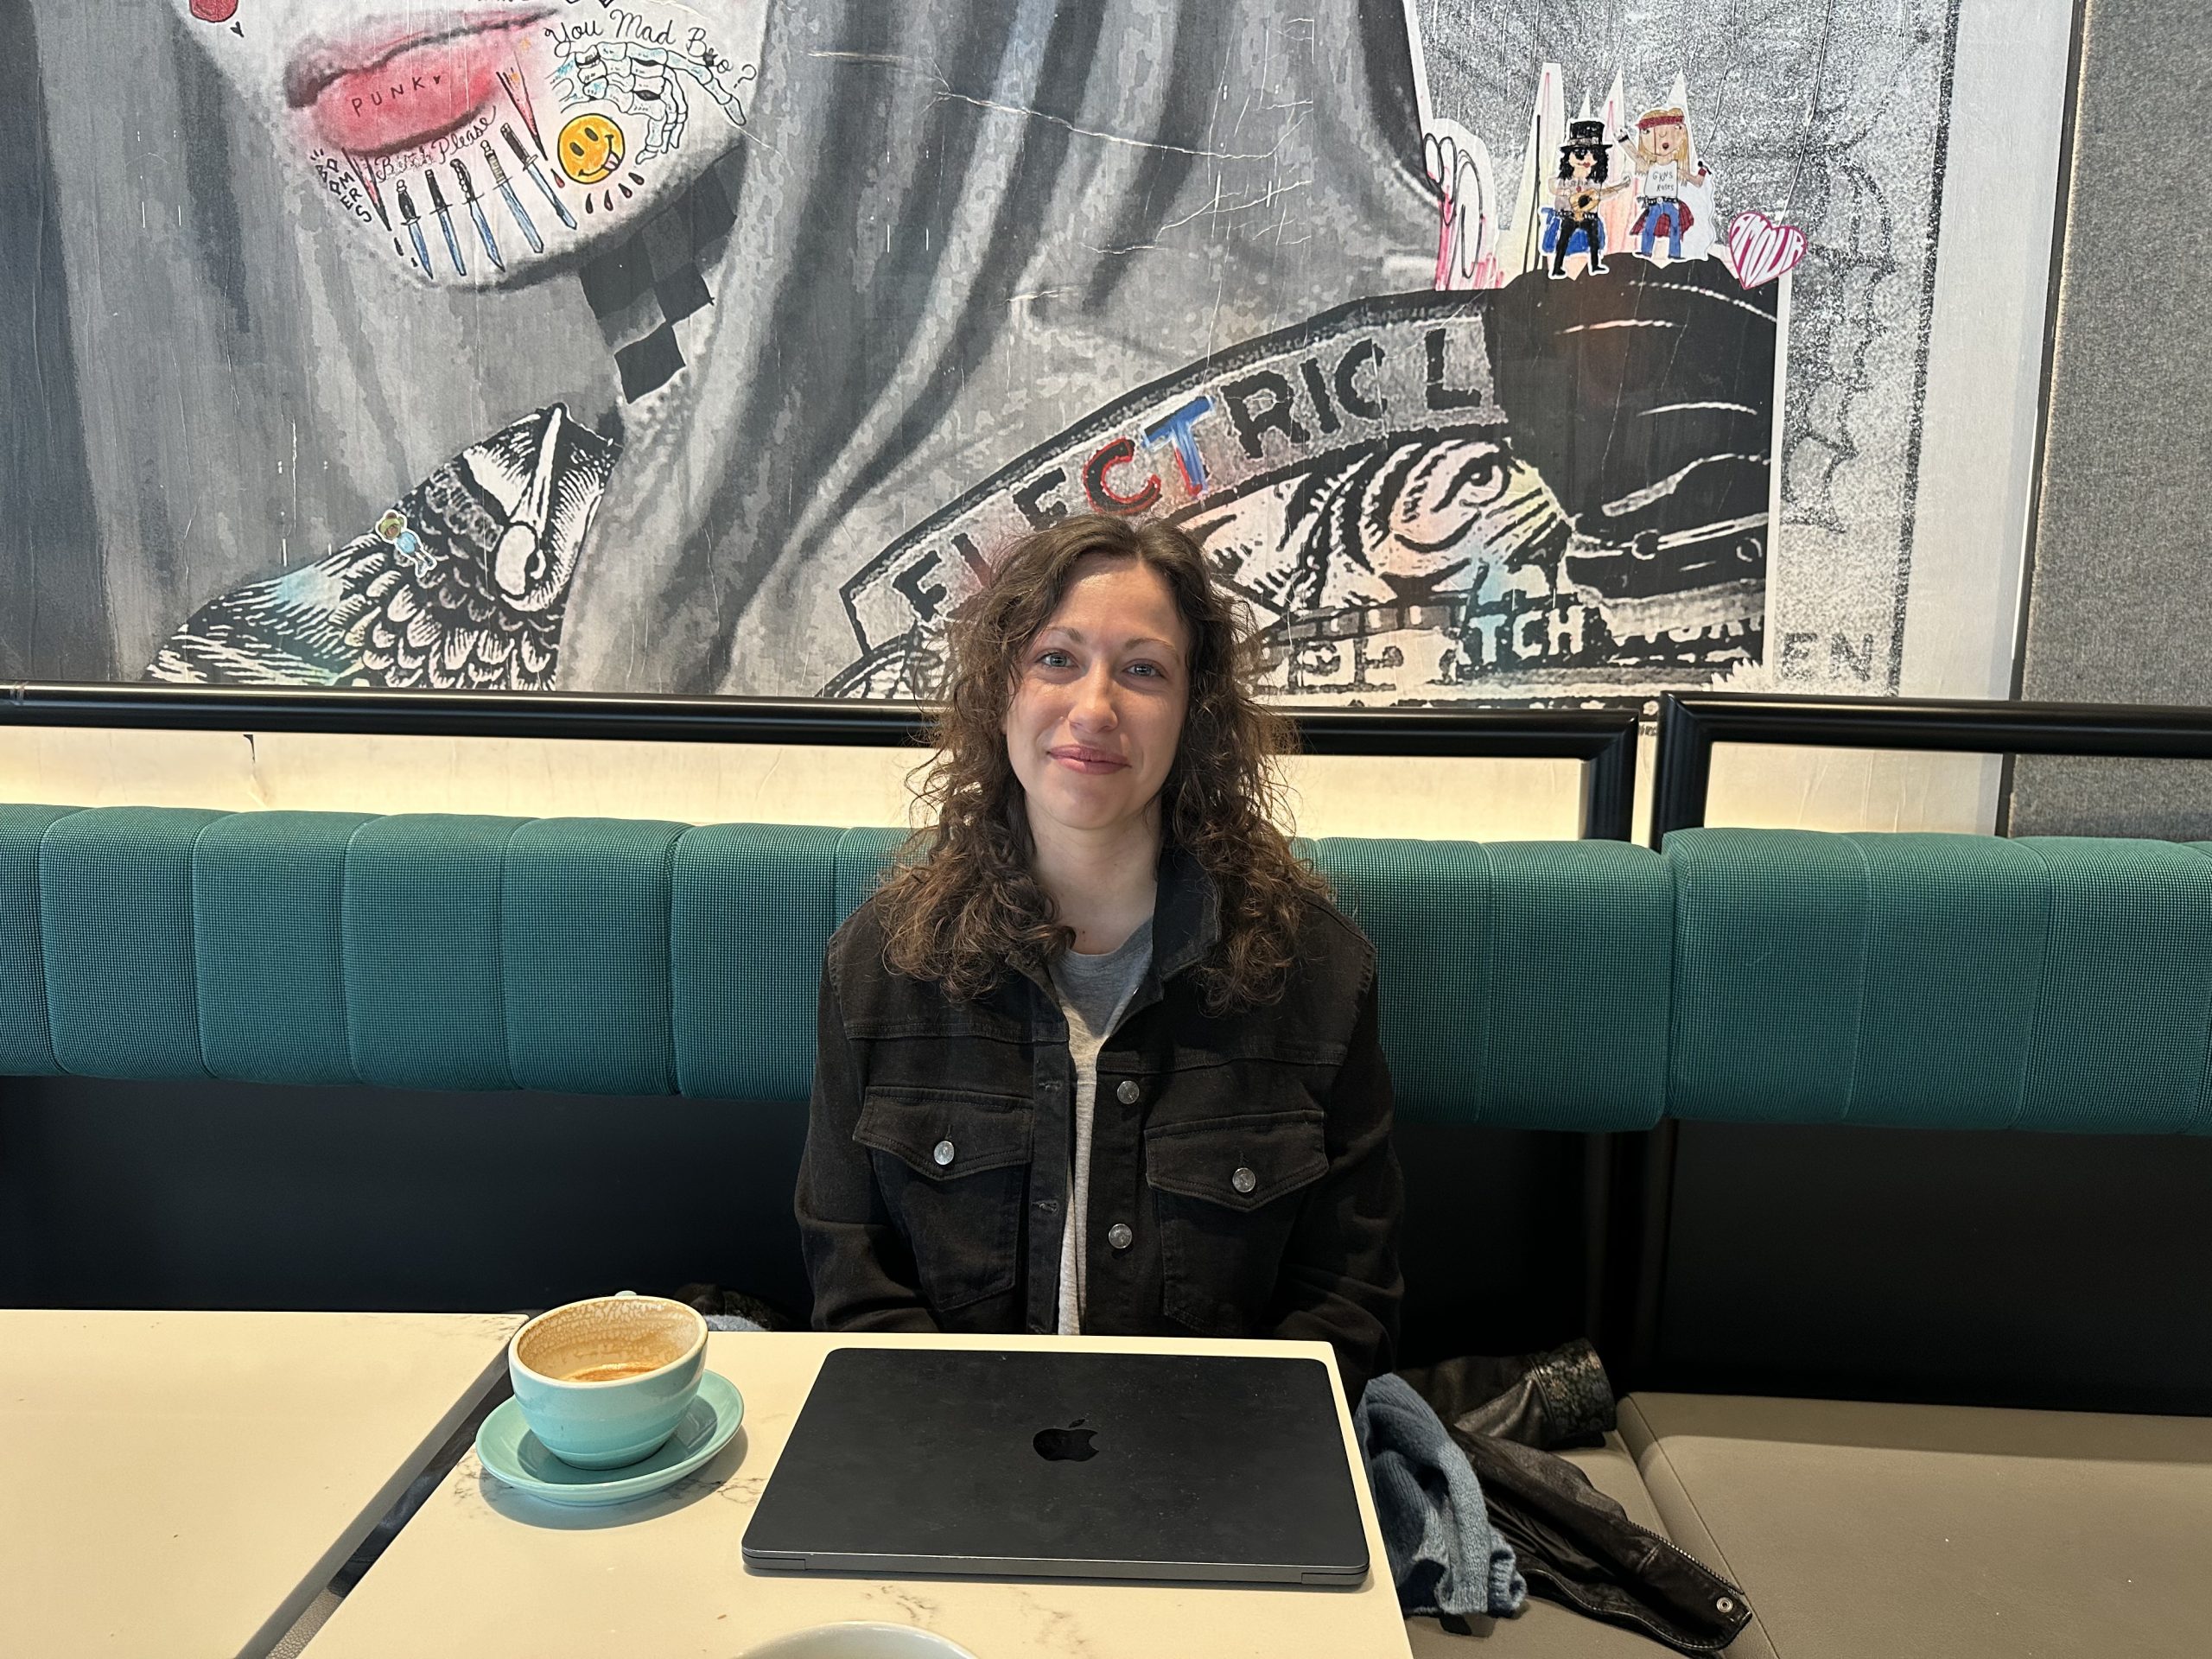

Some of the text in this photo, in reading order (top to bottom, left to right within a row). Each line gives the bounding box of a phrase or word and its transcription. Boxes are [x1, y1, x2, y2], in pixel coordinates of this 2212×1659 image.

[544, 21, 603, 58] You
[609, 9, 677, 45] Mad
[351, 75, 426, 118] PUNK
[431, 105, 497, 165] Please
[1730, 213, 1808, 289] AMOUR
